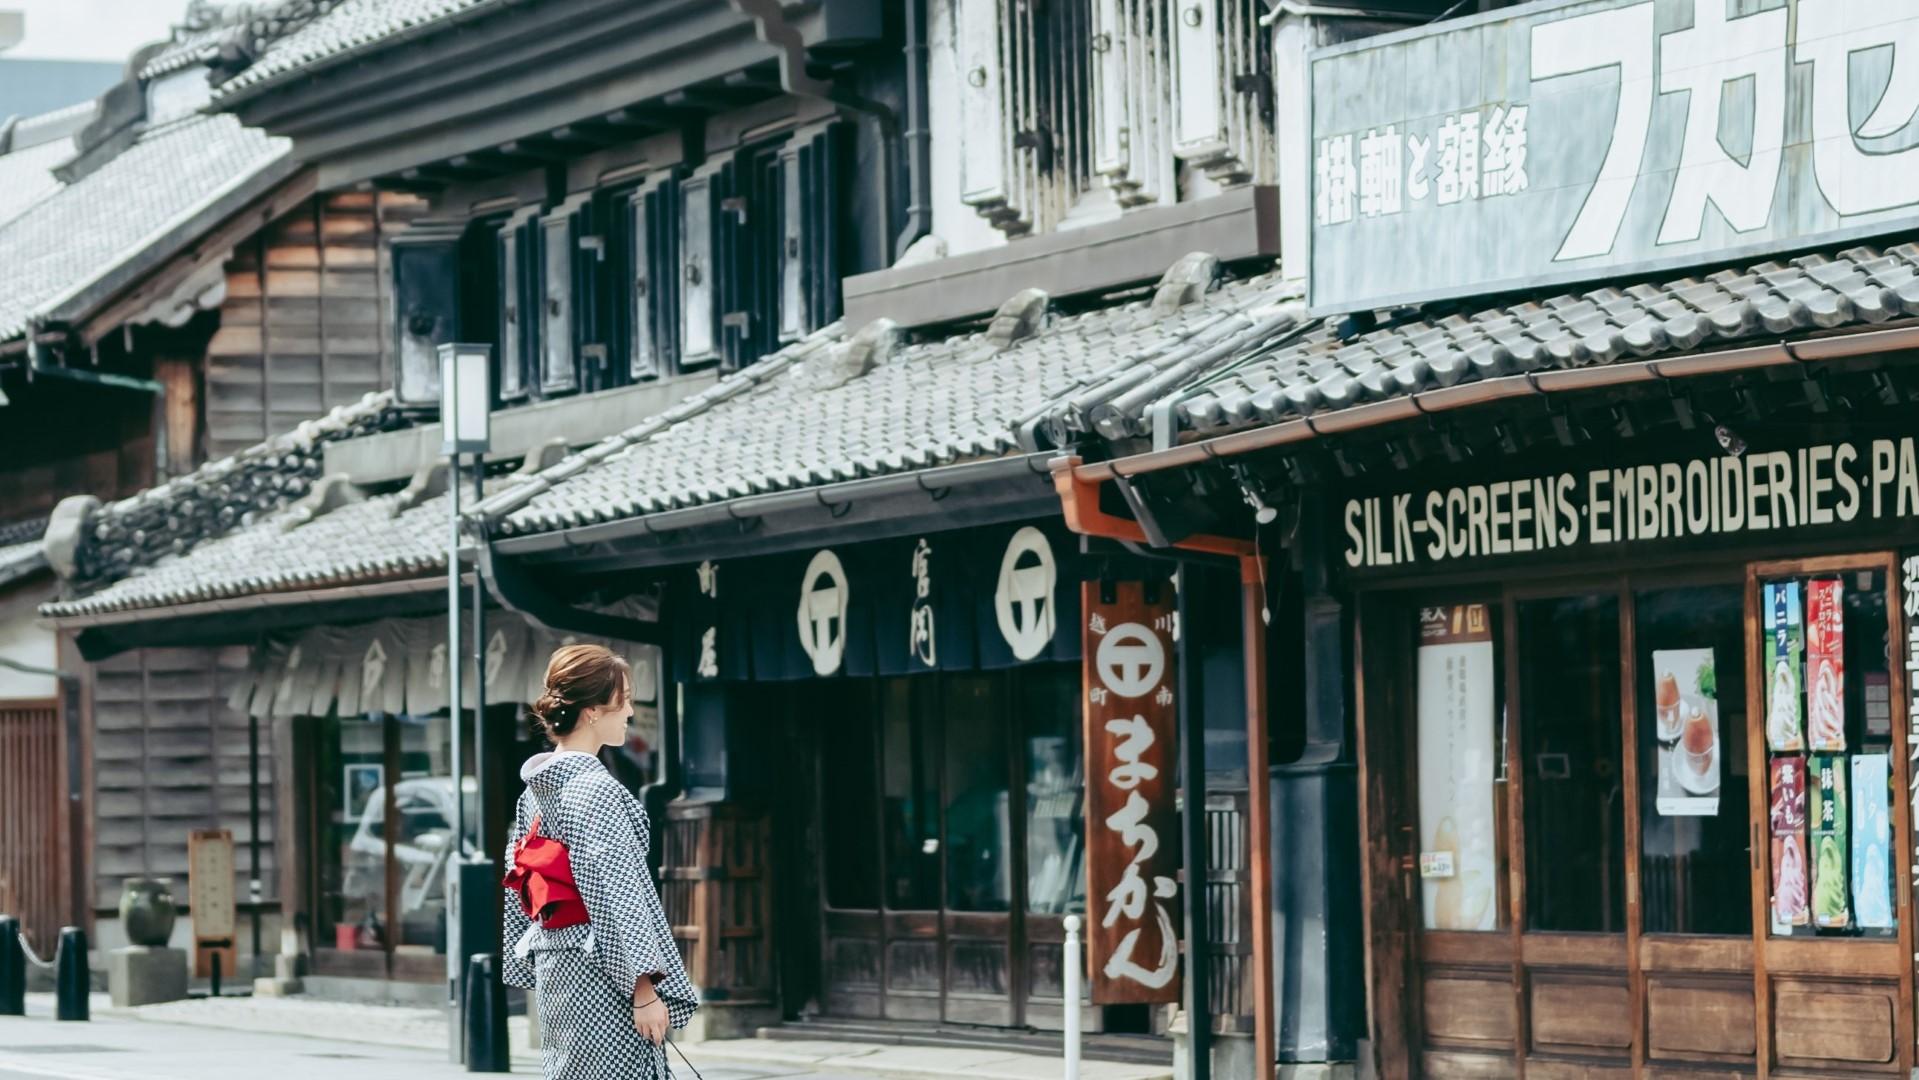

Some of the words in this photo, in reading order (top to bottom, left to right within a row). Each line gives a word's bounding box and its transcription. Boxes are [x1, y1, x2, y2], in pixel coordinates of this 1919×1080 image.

[1316, 103, 1529, 227] 掛軸と額縁
[1344, 473, 1579, 567] SILK-SCREENS
[1589, 443, 1860, 544] EMBROIDERIES
[1775, 589, 1788, 647] バニラ
[1102, 714, 1178, 989] まちかん
